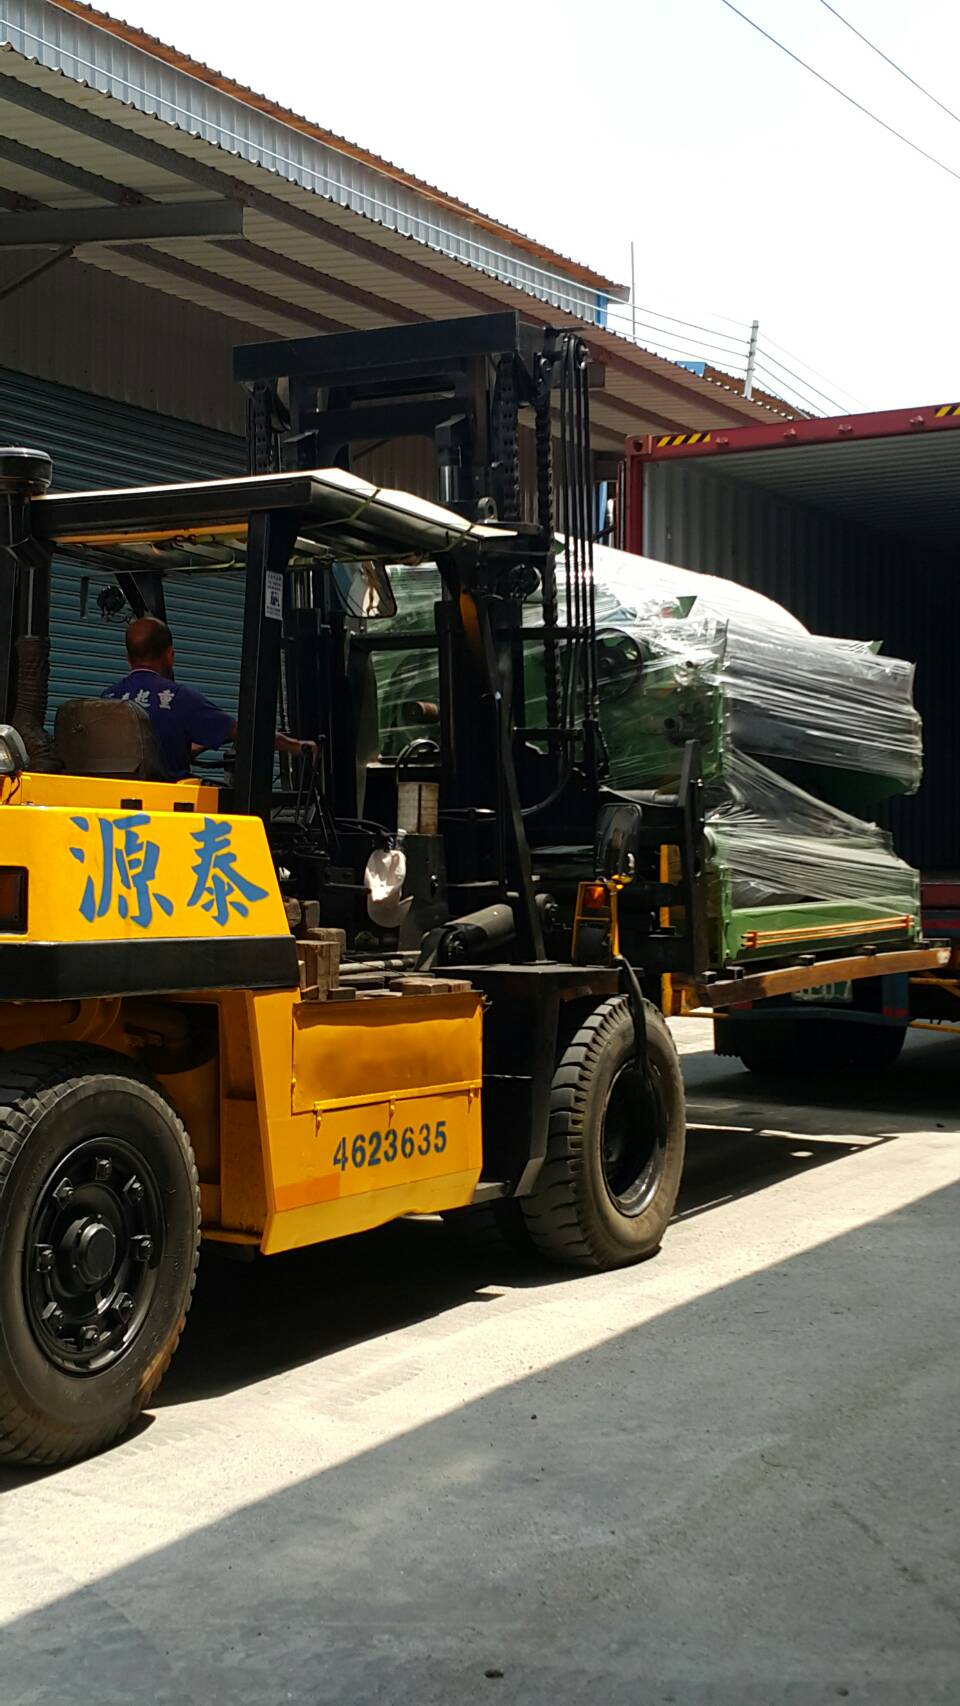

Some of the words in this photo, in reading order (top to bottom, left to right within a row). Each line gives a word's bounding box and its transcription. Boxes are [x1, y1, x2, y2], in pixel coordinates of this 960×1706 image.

[105, 689, 175, 710] 起重
[69, 813, 269, 928] 源泰
[333, 1120, 447, 1171] 4623635
